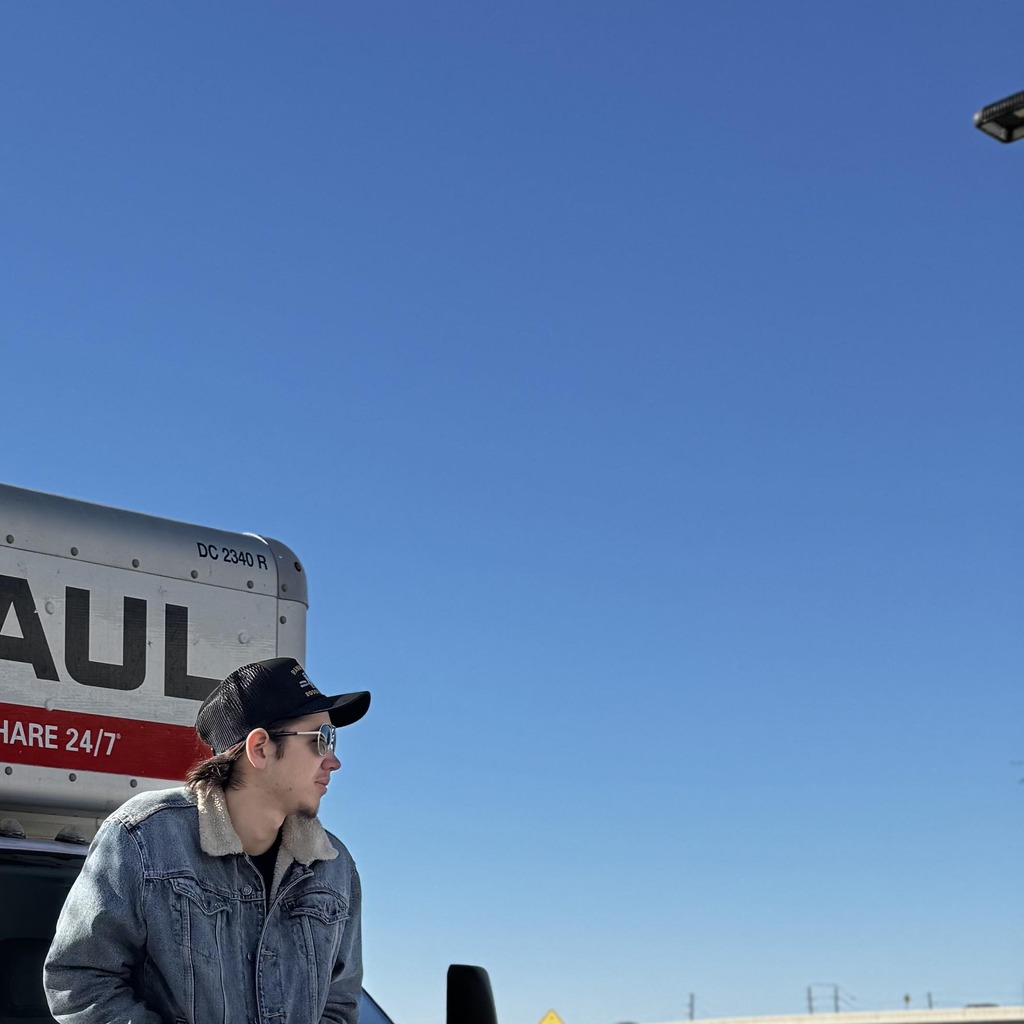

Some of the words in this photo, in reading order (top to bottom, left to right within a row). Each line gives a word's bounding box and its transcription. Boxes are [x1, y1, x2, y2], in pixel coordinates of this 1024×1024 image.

[197, 542, 219, 560] DC
[222, 548, 254, 567] 2340
[257, 554, 268, 570] R
